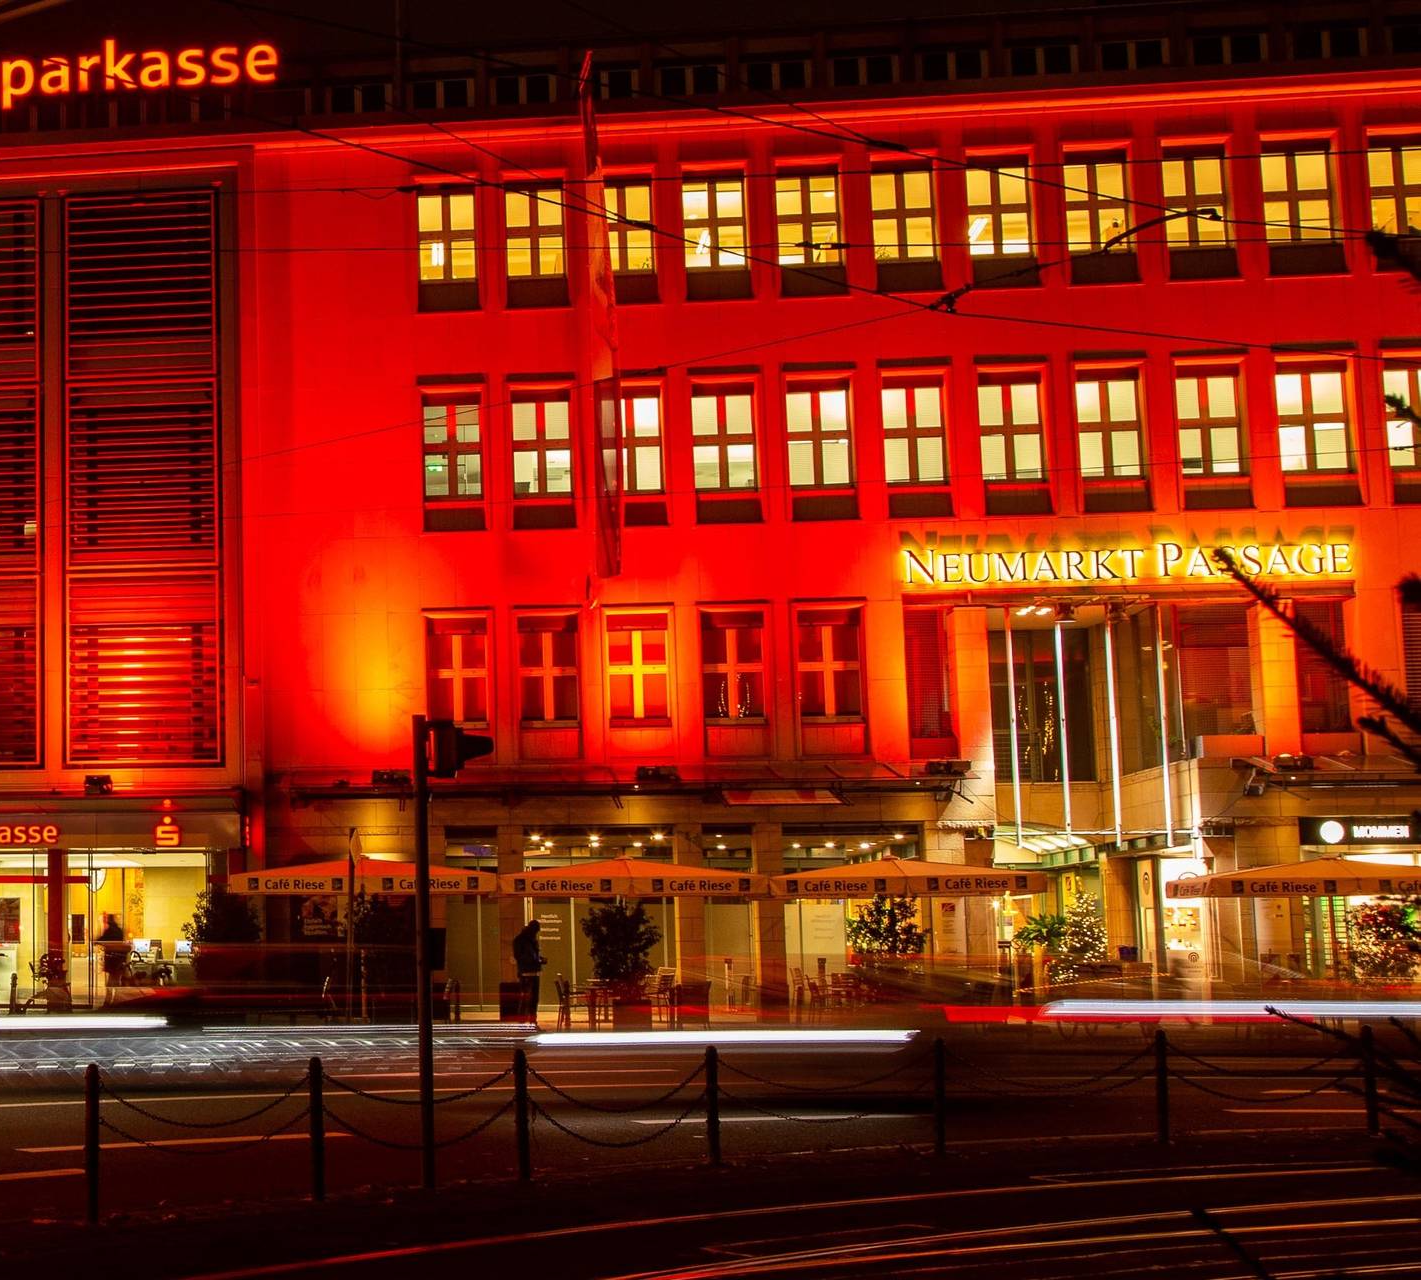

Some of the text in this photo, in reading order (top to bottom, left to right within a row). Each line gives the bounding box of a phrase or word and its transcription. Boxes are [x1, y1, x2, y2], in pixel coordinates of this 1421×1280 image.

[904, 548, 1144, 584] NEUMARKT
[1352, 825, 1410, 839] MOMMEN
[264, 878, 325, 890] Café Riese
[429, 878, 461, 889] Riese
[531, 879, 593, 891] Café Riese
[669, 879, 732, 891] Café Riese
[804, 880, 867, 892] Café Riese
[945, 878, 1008, 890] Café Riese
[1250, 881, 1317, 893] Café Riese
[1398, 881, 1421, 893] Caf
